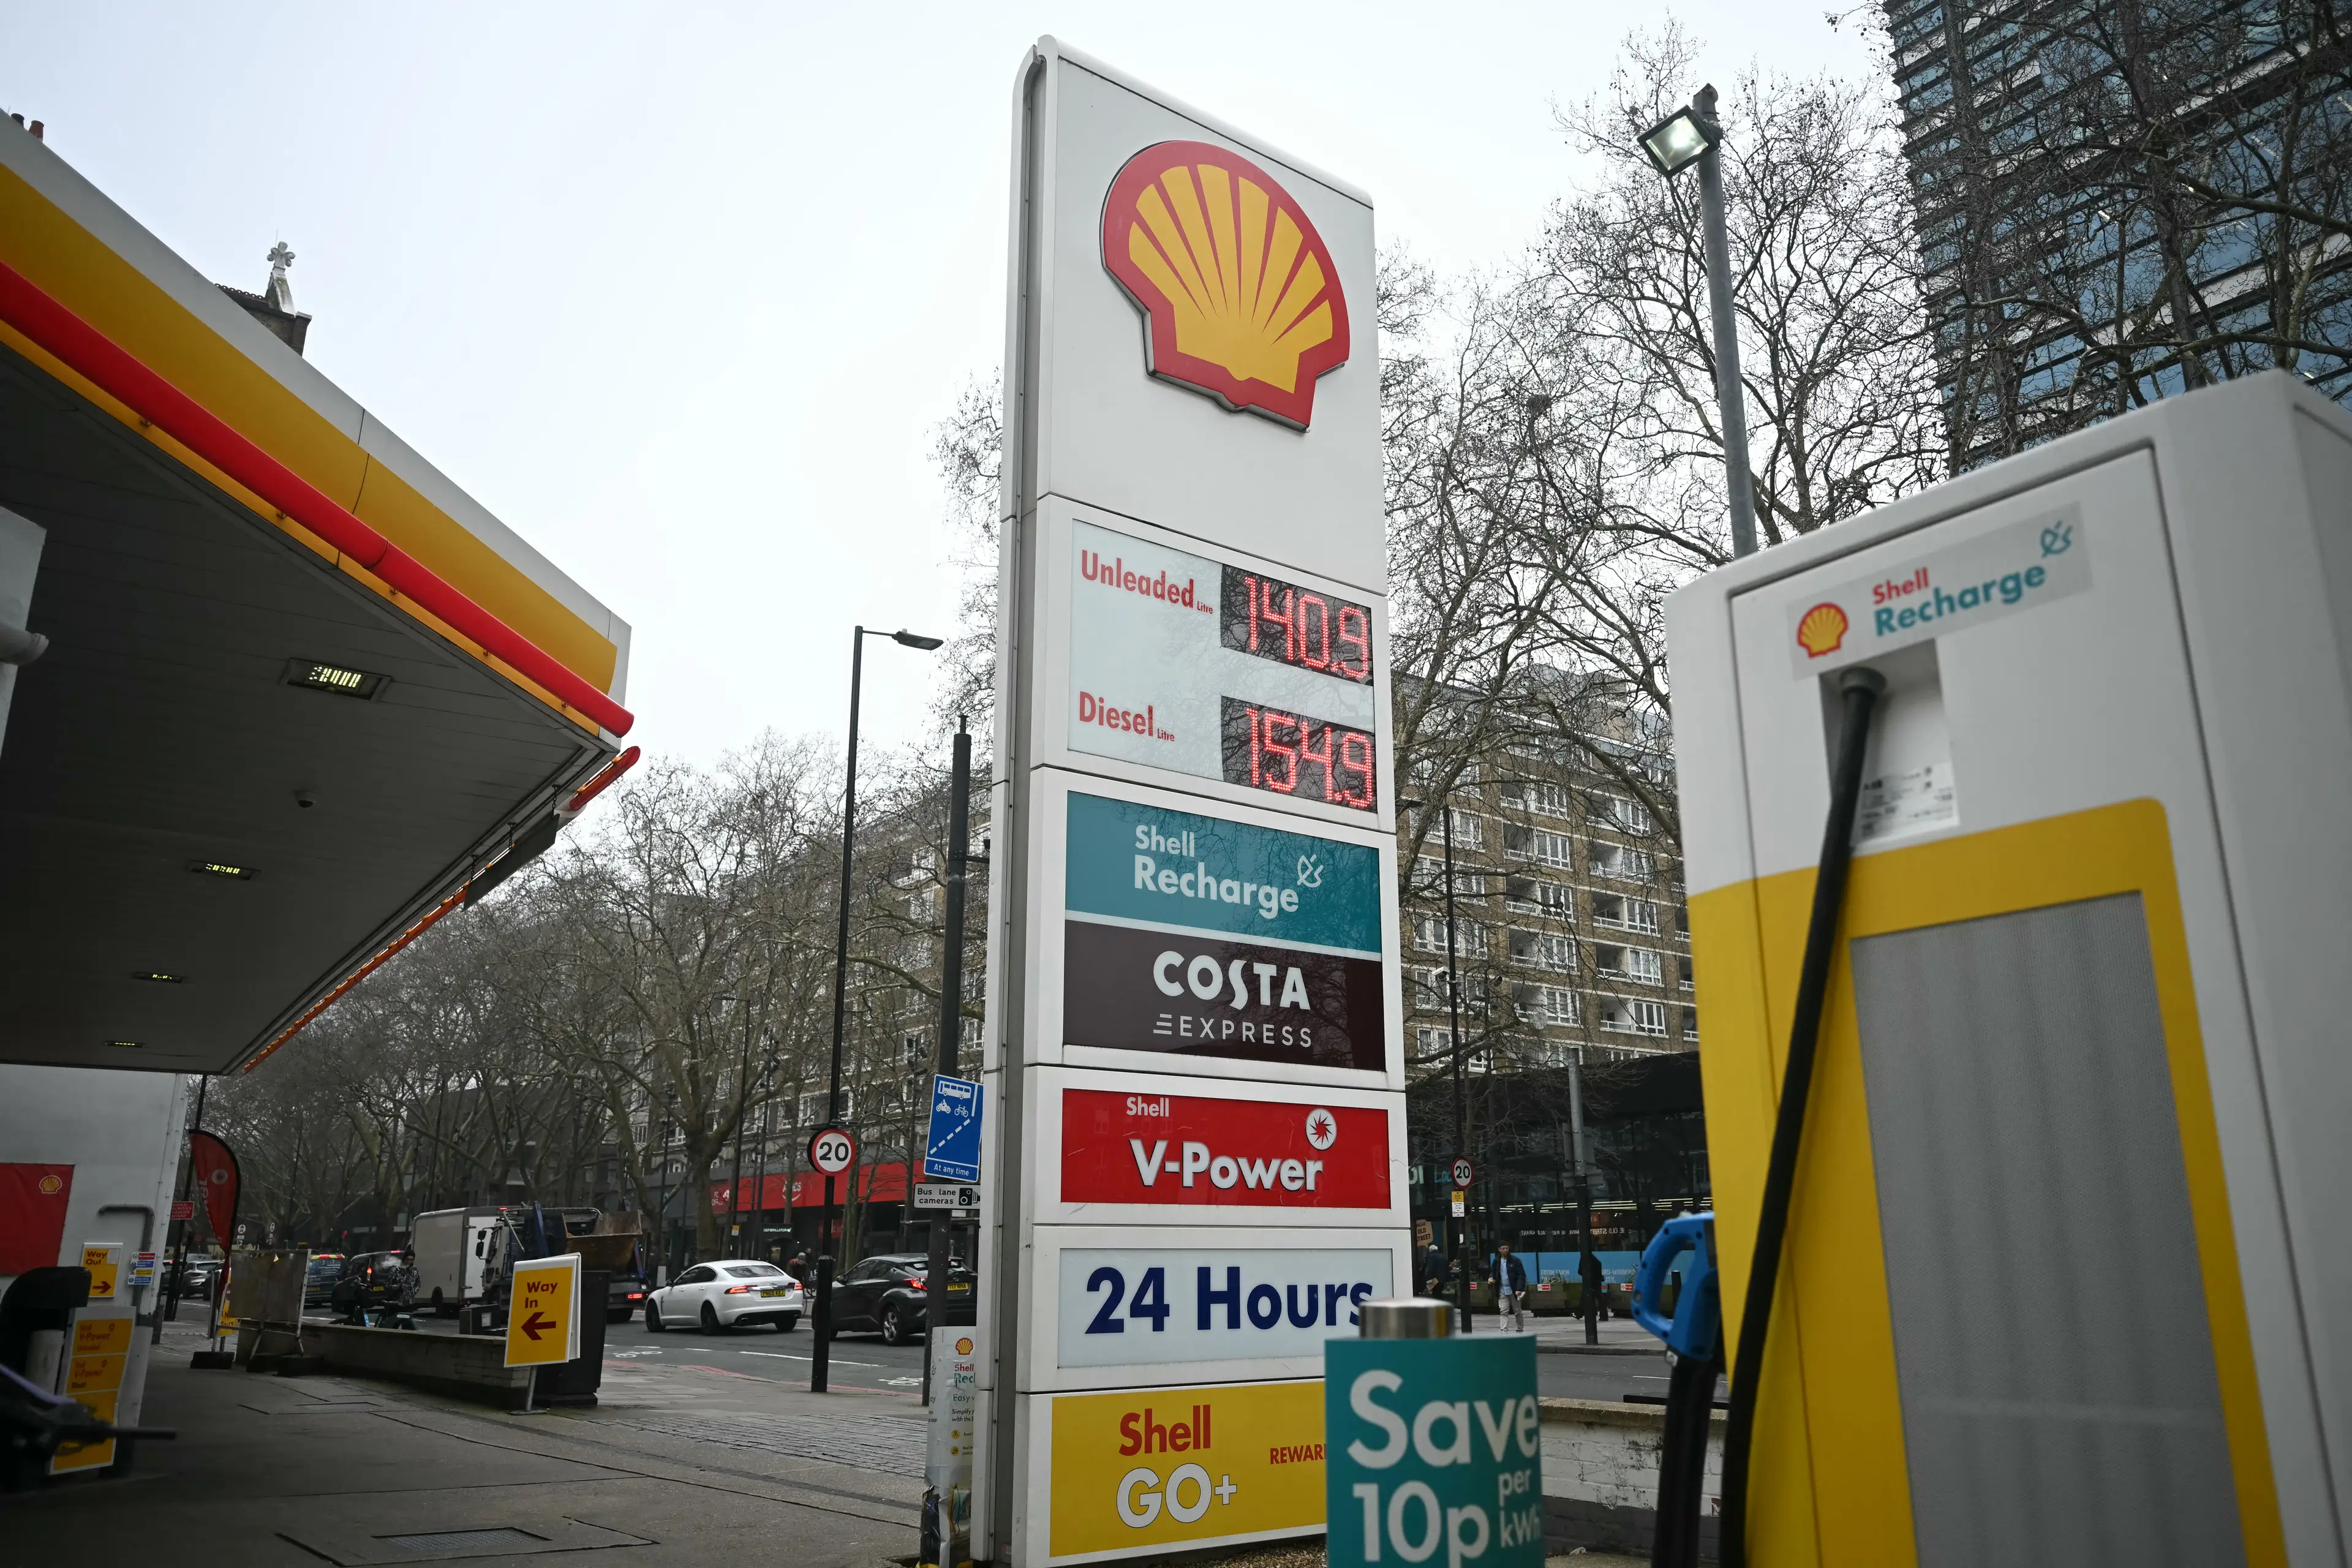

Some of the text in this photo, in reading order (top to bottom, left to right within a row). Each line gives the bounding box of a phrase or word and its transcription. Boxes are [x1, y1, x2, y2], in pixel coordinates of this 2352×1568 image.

[1081, 549, 1213, 615] Unleaded Litre
[1872, 567, 1930, 605] Shell
[1874, 564, 2046, 638] Recharge
[1244, 576, 1369, 678] 140.9
[1079, 692, 1175, 742] Diesel Litre
[1246, 707, 1373, 807] 154.9
[1136, 824, 1195, 858] Shell
[1134, 854, 1299, 919] Recharge
[1153, 951, 1311, 1011] COSTA
[1180, 1016, 1311, 1047] EXPRESS
[1126, 1096, 1170, 1117] Shell
[819, 1142, 849, 1162] 20
[943, 1166, 954, 1175] any
[956, 1167, 970, 1176] time
[1129, 1139, 1323, 1192] V-Power
[1409, 1165, 1452, 1185] DI Loc
[1455, 1166, 1471, 1179] 20
[524, 1297, 538, 1309] In
[527, 1281, 559, 1294] Way
[1085, 1266, 1373, 1335] 24 Hours
[954, 1363, 974, 1372] Shell
[952, 1409, 971, 1418] Simplify
[953, 1394, 970, 1403] Easy
[1118, 1404, 1211, 1457] Shell
[1348, 1369, 1539, 1470] Save
[1270, 1444, 1327, 1464] REWAR
[1116, 1462, 1238, 1528] GO+
[1498, 1469, 1533, 1508] per
[1352, 1480, 1490, 1568] 10p
